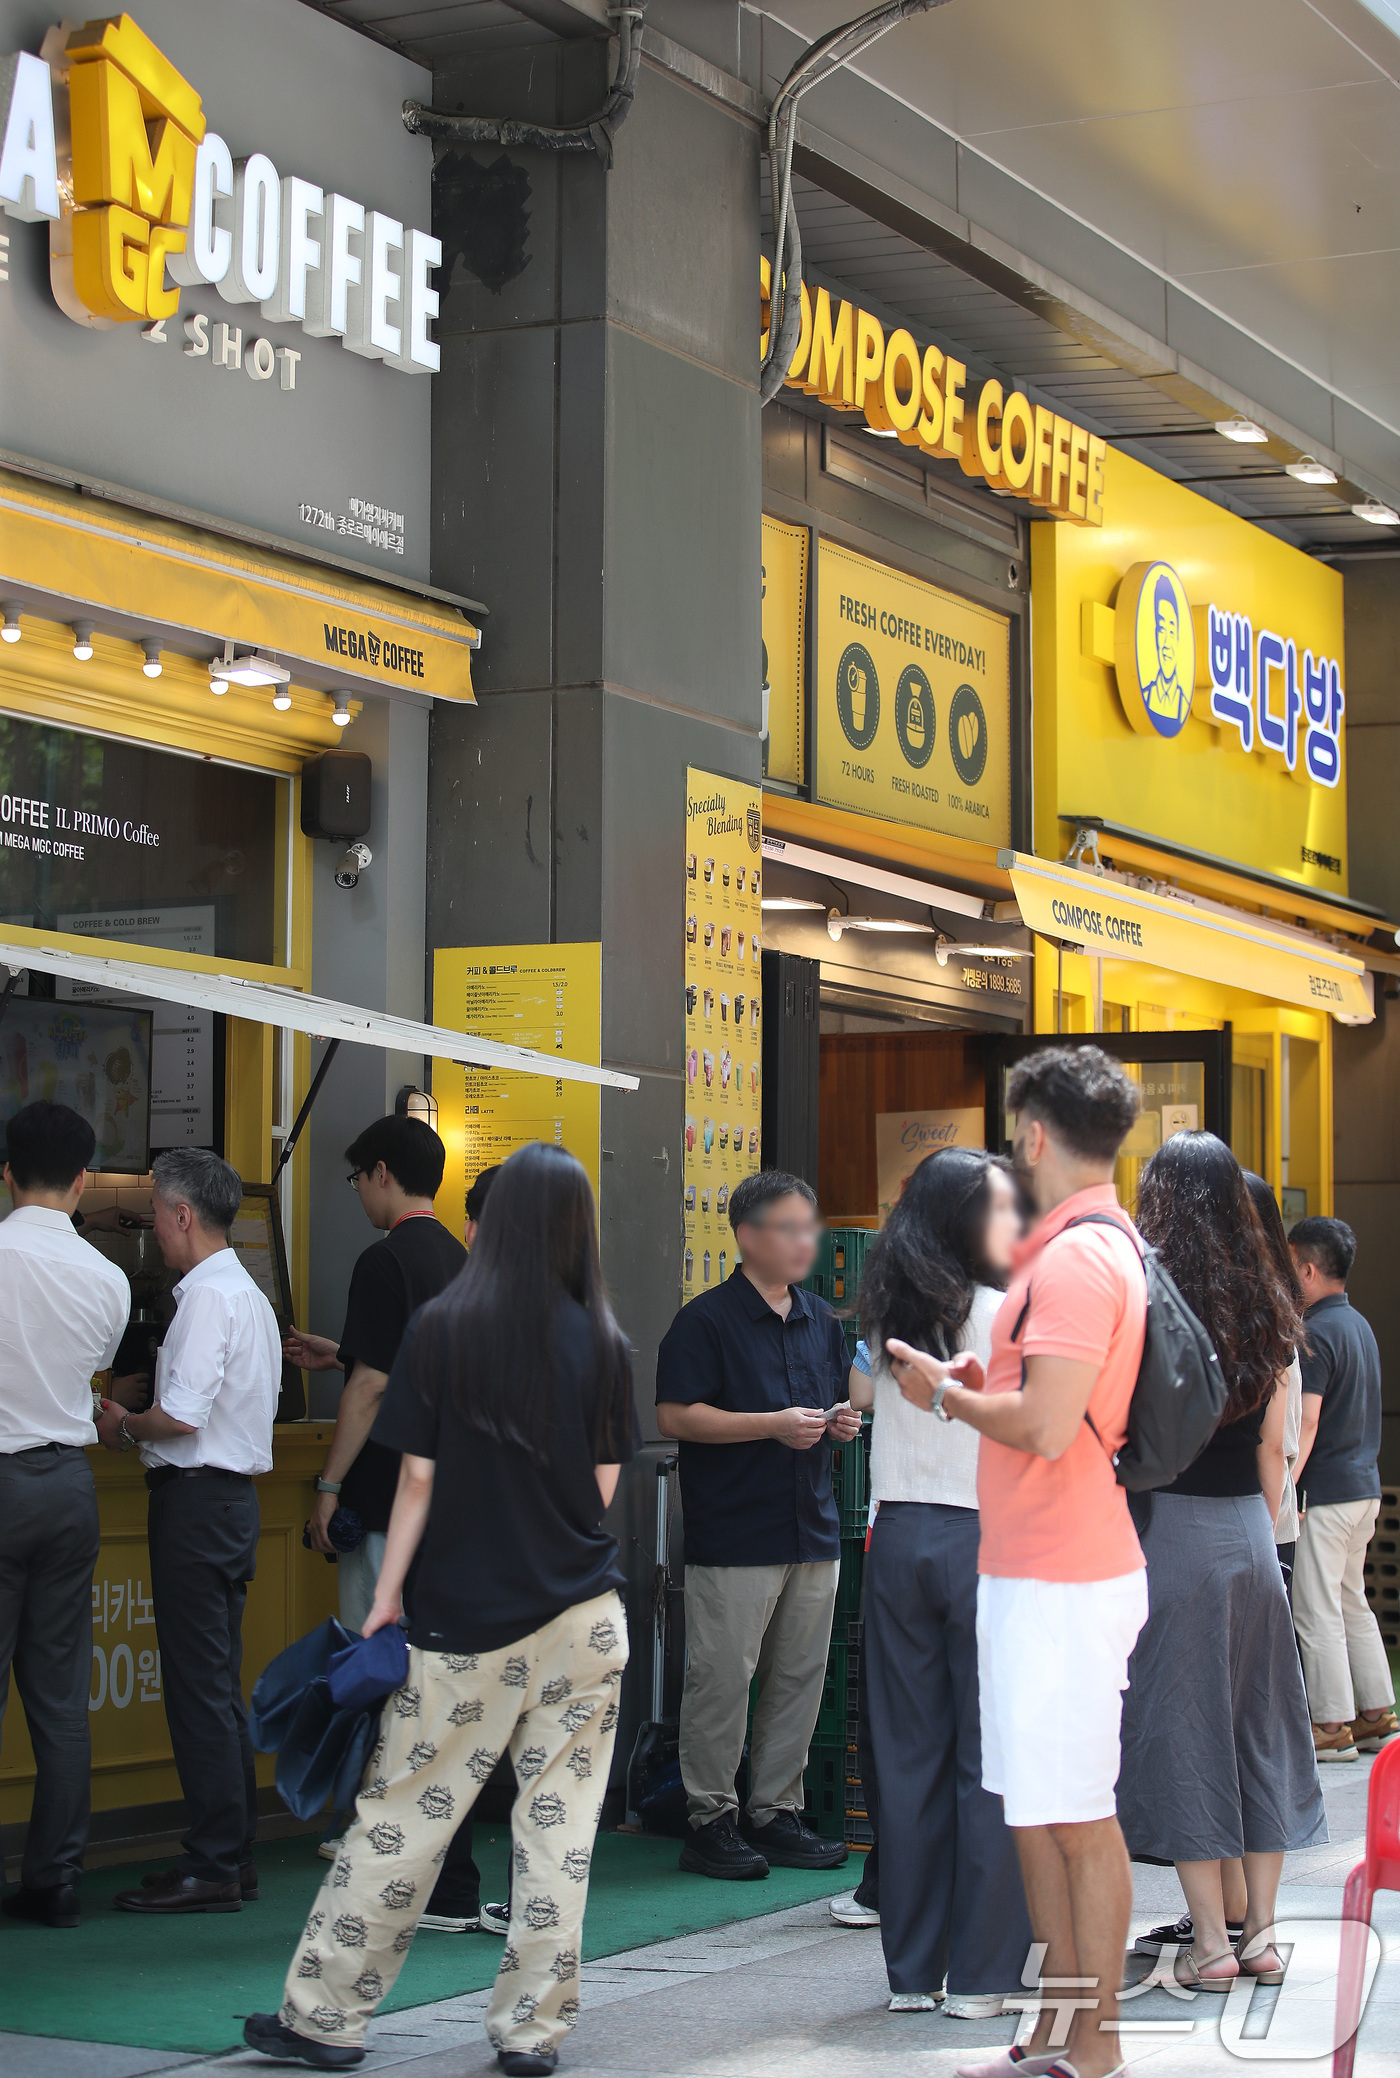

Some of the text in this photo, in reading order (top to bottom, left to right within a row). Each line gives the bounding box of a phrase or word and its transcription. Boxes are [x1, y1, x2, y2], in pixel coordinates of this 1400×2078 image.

[194, 132, 443, 374] COFFEE
[184, 313, 302, 391] SHOT
[963, 378, 1107, 528] COFFEE
[298, 503, 335, 531] 1272th
[839, 594, 987, 676] FRESH COFFEE EVERYDAY!
[323, 623, 369, 662] MEGA
[382, 640, 425, 678] COFFEE
[1208, 603, 1345, 789] 빽다방
[841, 761, 875, 785] 72 HOURS
[891, 776, 940, 804] FRESH ROASTED
[687, 793, 726, 822] Specialty
[947, 793, 991, 820] 100% ARABICA
[56, 806, 71, 830] IL
[73, 810, 121, 839] PRIMO
[123, 820, 160, 847] Coffee
[706, 814, 744, 837] Blending
[4, 832, 85, 861] MEGA MGC COFFEE
[73, 916, 160, 929] COFFEE & COLD BREW
[1052, 899, 1143, 948] COMPOSE COFFEE
[466, 965, 481, 976] 커피
[482, 966, 488, 975] &
[489, 964, 518, 975] 콜드브루
[961, 967, 1022, 995] 가맹문의 1899.5685
